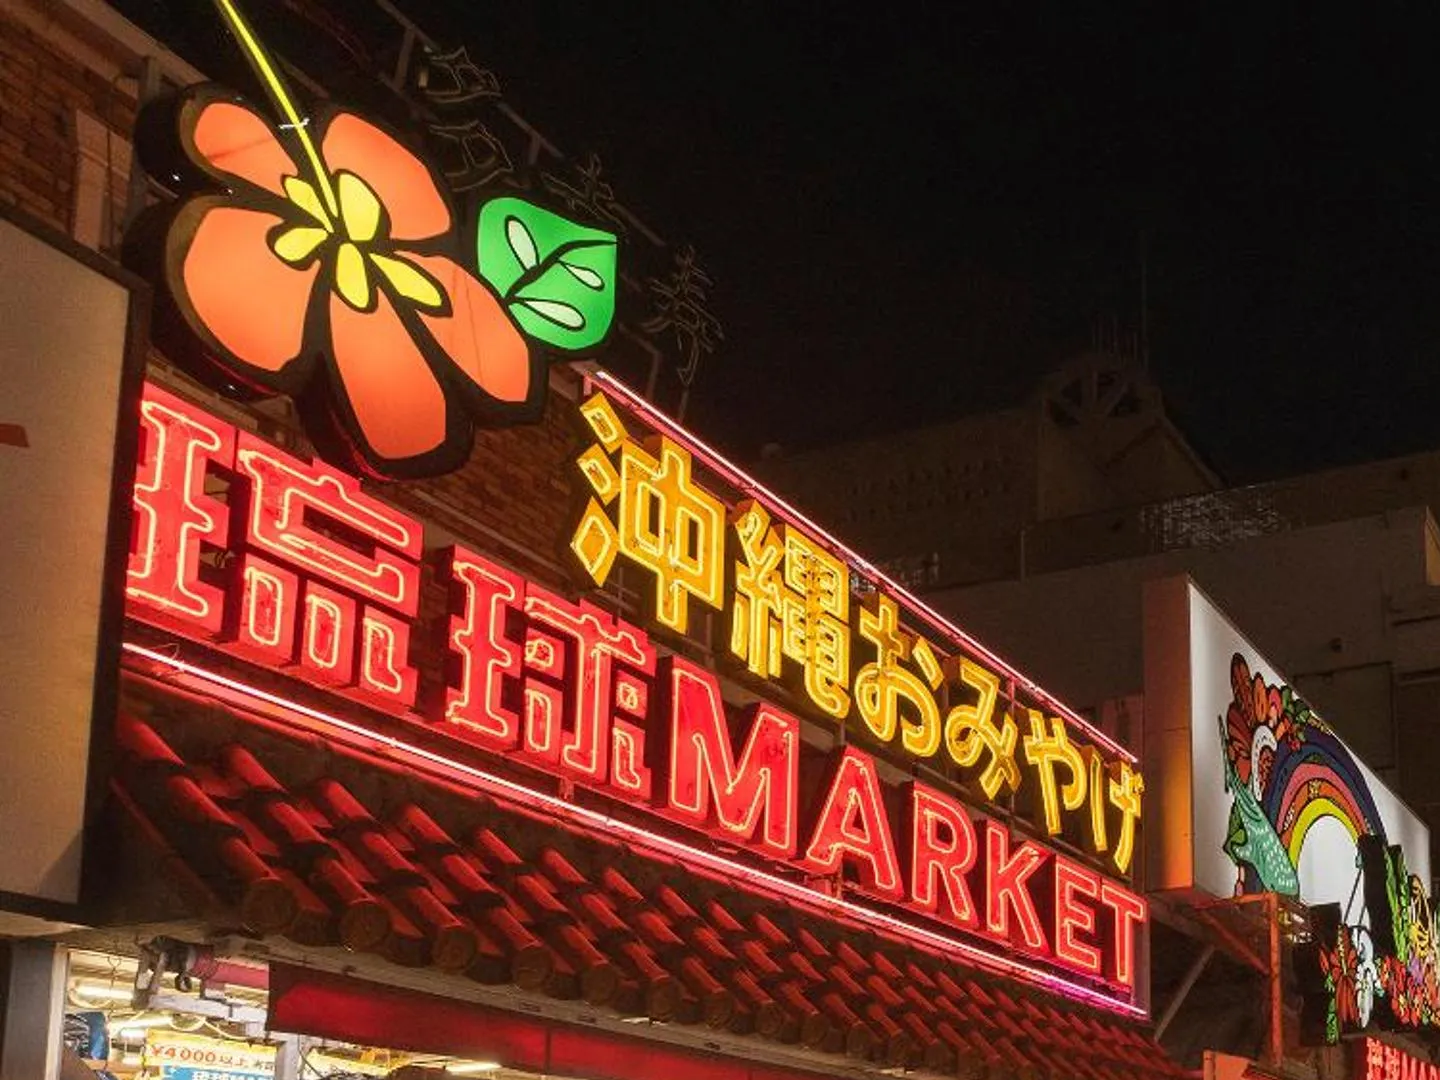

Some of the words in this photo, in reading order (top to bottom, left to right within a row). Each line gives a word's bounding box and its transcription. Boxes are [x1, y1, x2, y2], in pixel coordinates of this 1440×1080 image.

[571, 392, 1145, 874] 沖縄おみやげ
